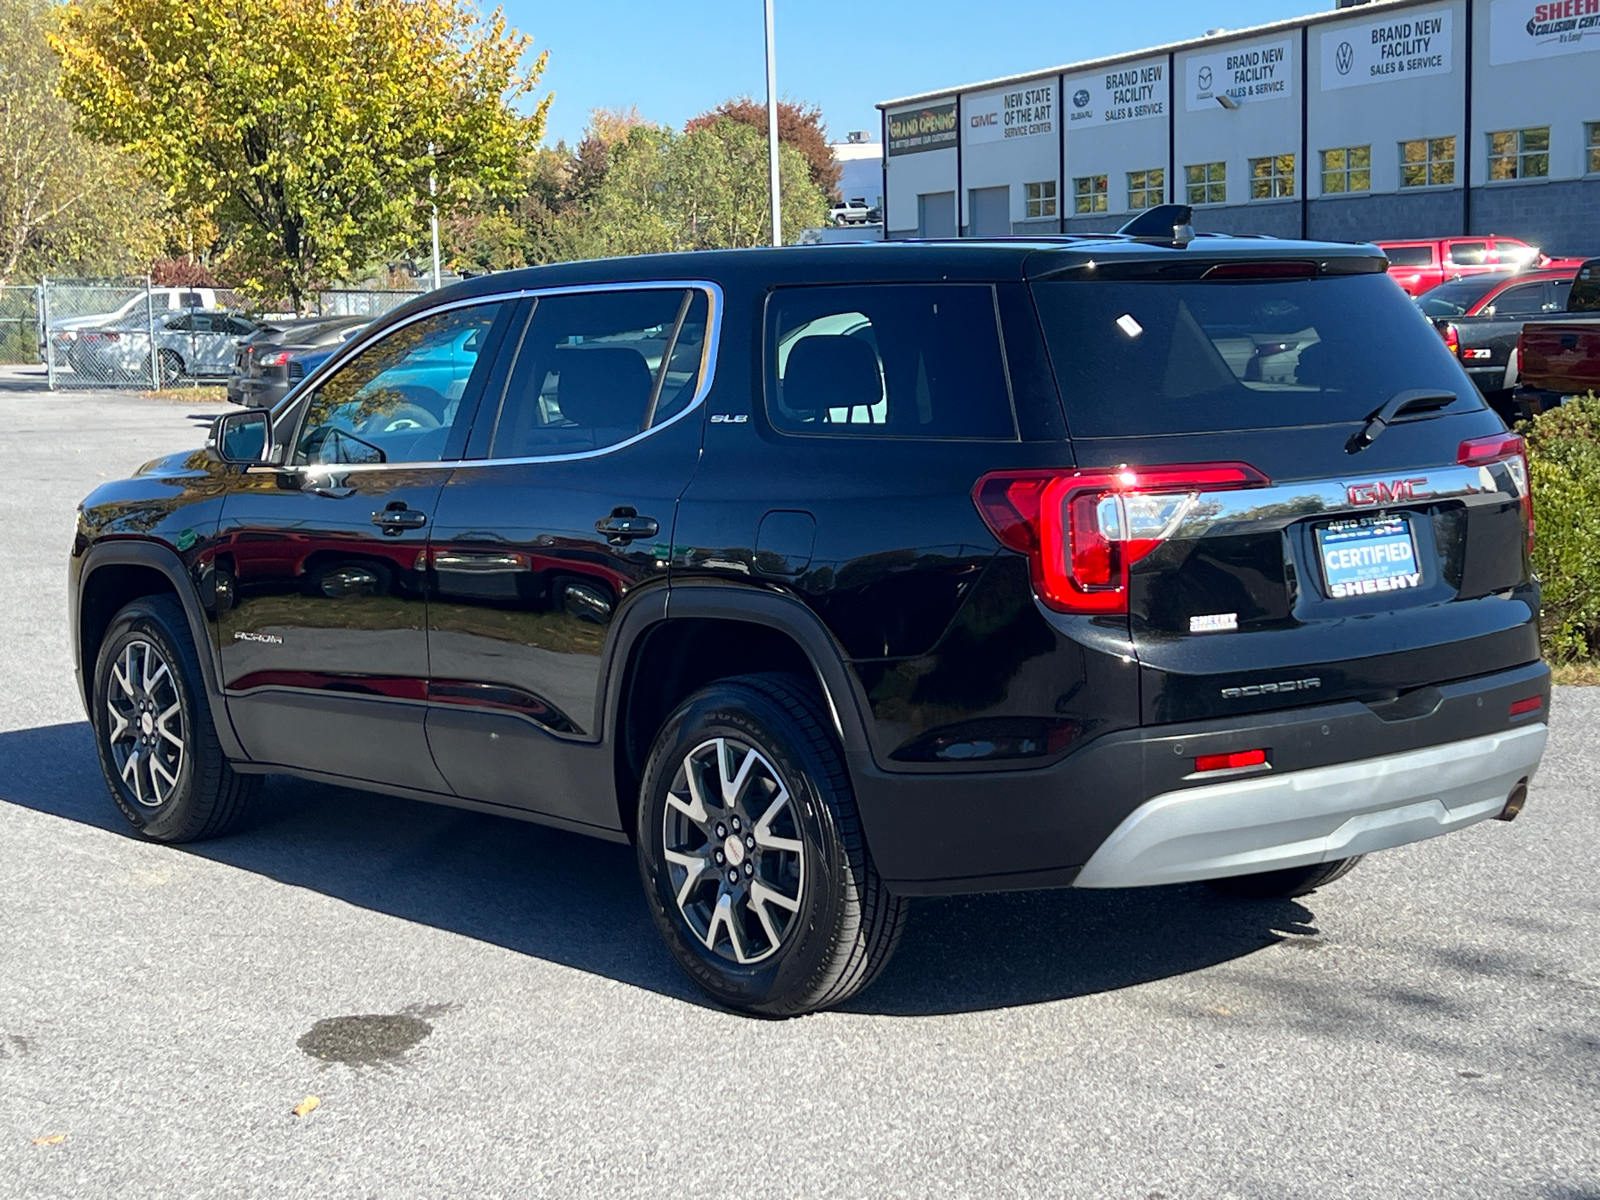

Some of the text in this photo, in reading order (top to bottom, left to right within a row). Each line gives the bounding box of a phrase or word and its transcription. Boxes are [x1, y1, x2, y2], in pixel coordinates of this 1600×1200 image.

[1371, 18, 1442, 44] BRAND NEW
[1535, 14, 1600, 36] COLLISION CENT
[1227, 47, 1284, 70] BRAND NEW
[1381, 37, 1431, 59] FACILITY
[1234, 64, 1275, 84] FACILITY
[1370, 55, 1442, 76] SALES & SERVICE
[1106, 65, 1162, 90] BRAND NEW
[1004, 87, 1051, 109] NEW STATE
[1114, 84, 1154, 105] FACILITY
[1226, 87, 1246, 98] SALES
[1248, 85, 1254, 95] &
[1255, 81, 1284, 94] SERVICE
[971, 112, 998, 128] GMC
[1004, 105, 1051, 126] OF THE ART
[1070, 110, 1092, 121] SUBARU
[1105, 102, 1163, 121] SALES & SERVICE
[890, 112, 956, 138] GRAND OPENING
[1004, 121, 1051, 138] SERVICE CENTER
[1463, 349, 1491, 359] Z71
[1349, 477, 1430, 506] GMC
[1328, 519, 1358, 532] AUTO
[1325, 542, 1412, 570] CERTIFIED
[1331, 573, 1420, 598] SHEEHY
[1190, 613, 1237, 625] SHEEHY
[234, 631, 283, 644] ACADIA
[1221, 677, 1321, 699] ACADIA
